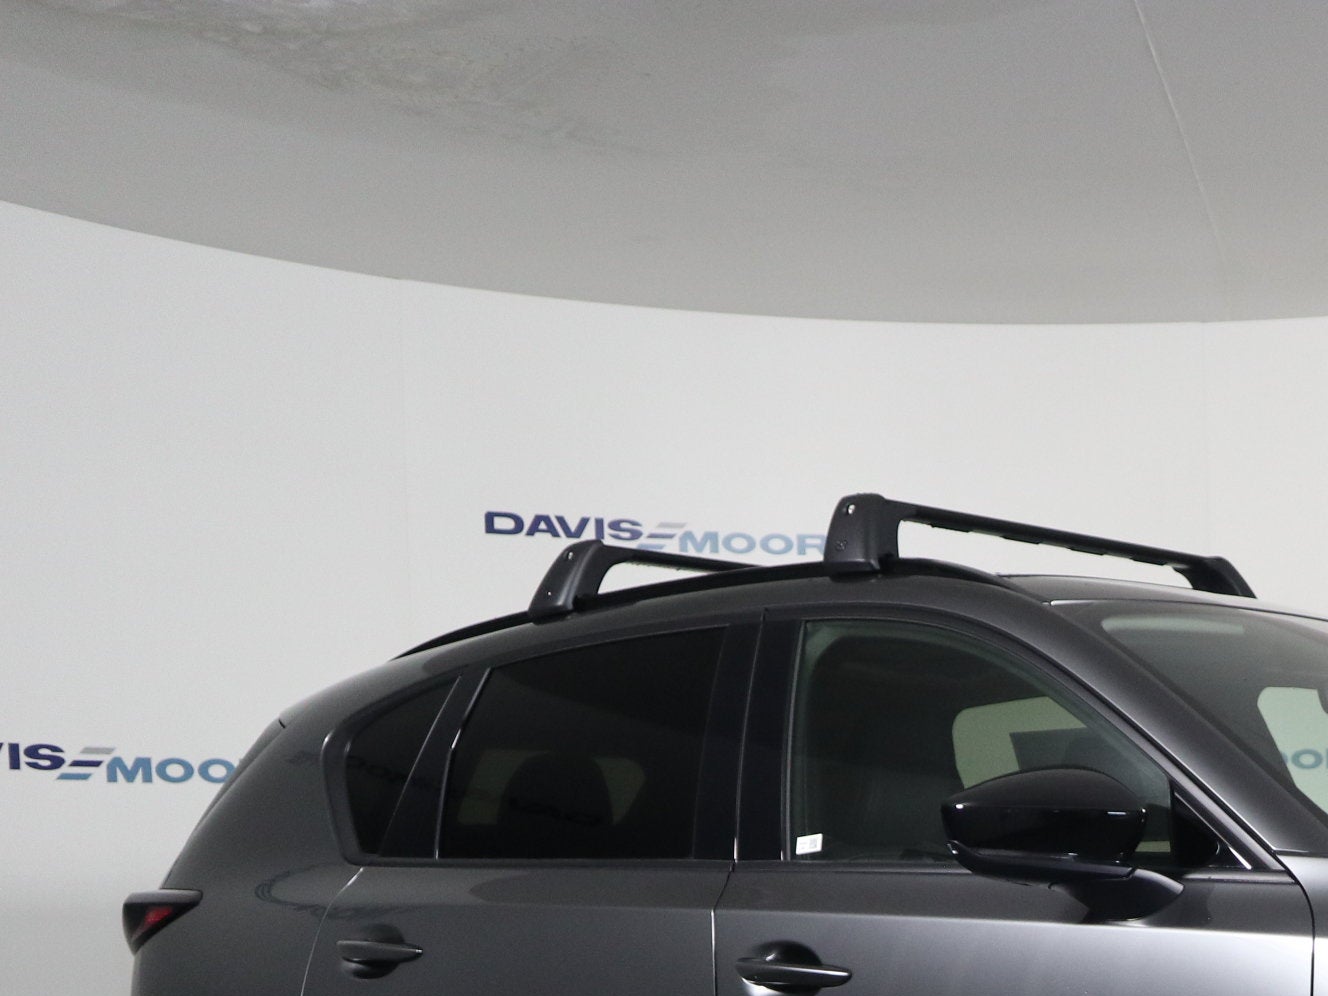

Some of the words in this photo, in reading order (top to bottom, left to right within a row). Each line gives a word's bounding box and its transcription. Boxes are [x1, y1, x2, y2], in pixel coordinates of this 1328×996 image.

[484, 511, 643, 540] DAVIS
[678, 530, 828, 556] MOOR
[106, 756, 243, 784] MOO
